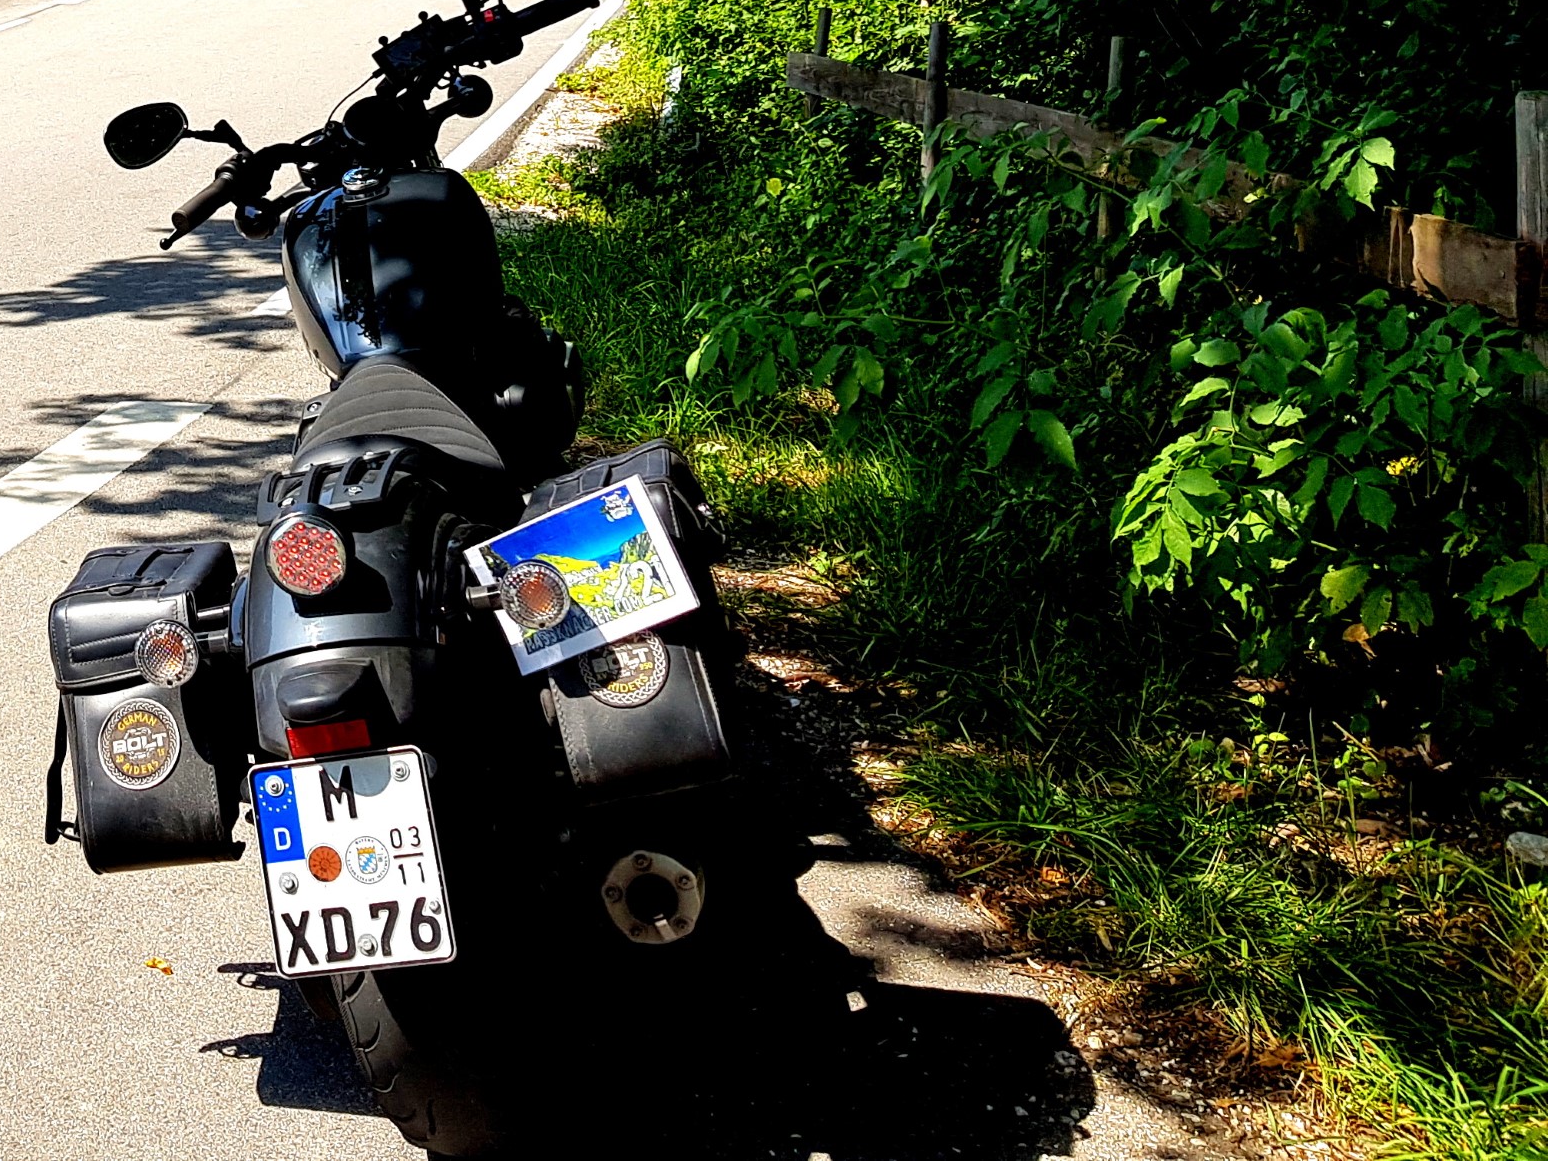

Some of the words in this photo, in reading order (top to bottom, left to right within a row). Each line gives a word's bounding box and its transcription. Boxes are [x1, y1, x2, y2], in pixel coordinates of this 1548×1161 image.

[607, 674, 649, 693] RIDERS
[117, 711, 157, 731] GERMAN
[113, 732, 168, 754] BOLT
[122, 760, 159, 775] RIDERS
[318, 765, 358, 822] M
[273, 827, 291, 851] D
[390, 826, 421, 849] 03
[398, 861, 425, 886] 11
[281, 907, 357, 968] XD
[369, 897, 442, 957] 76
